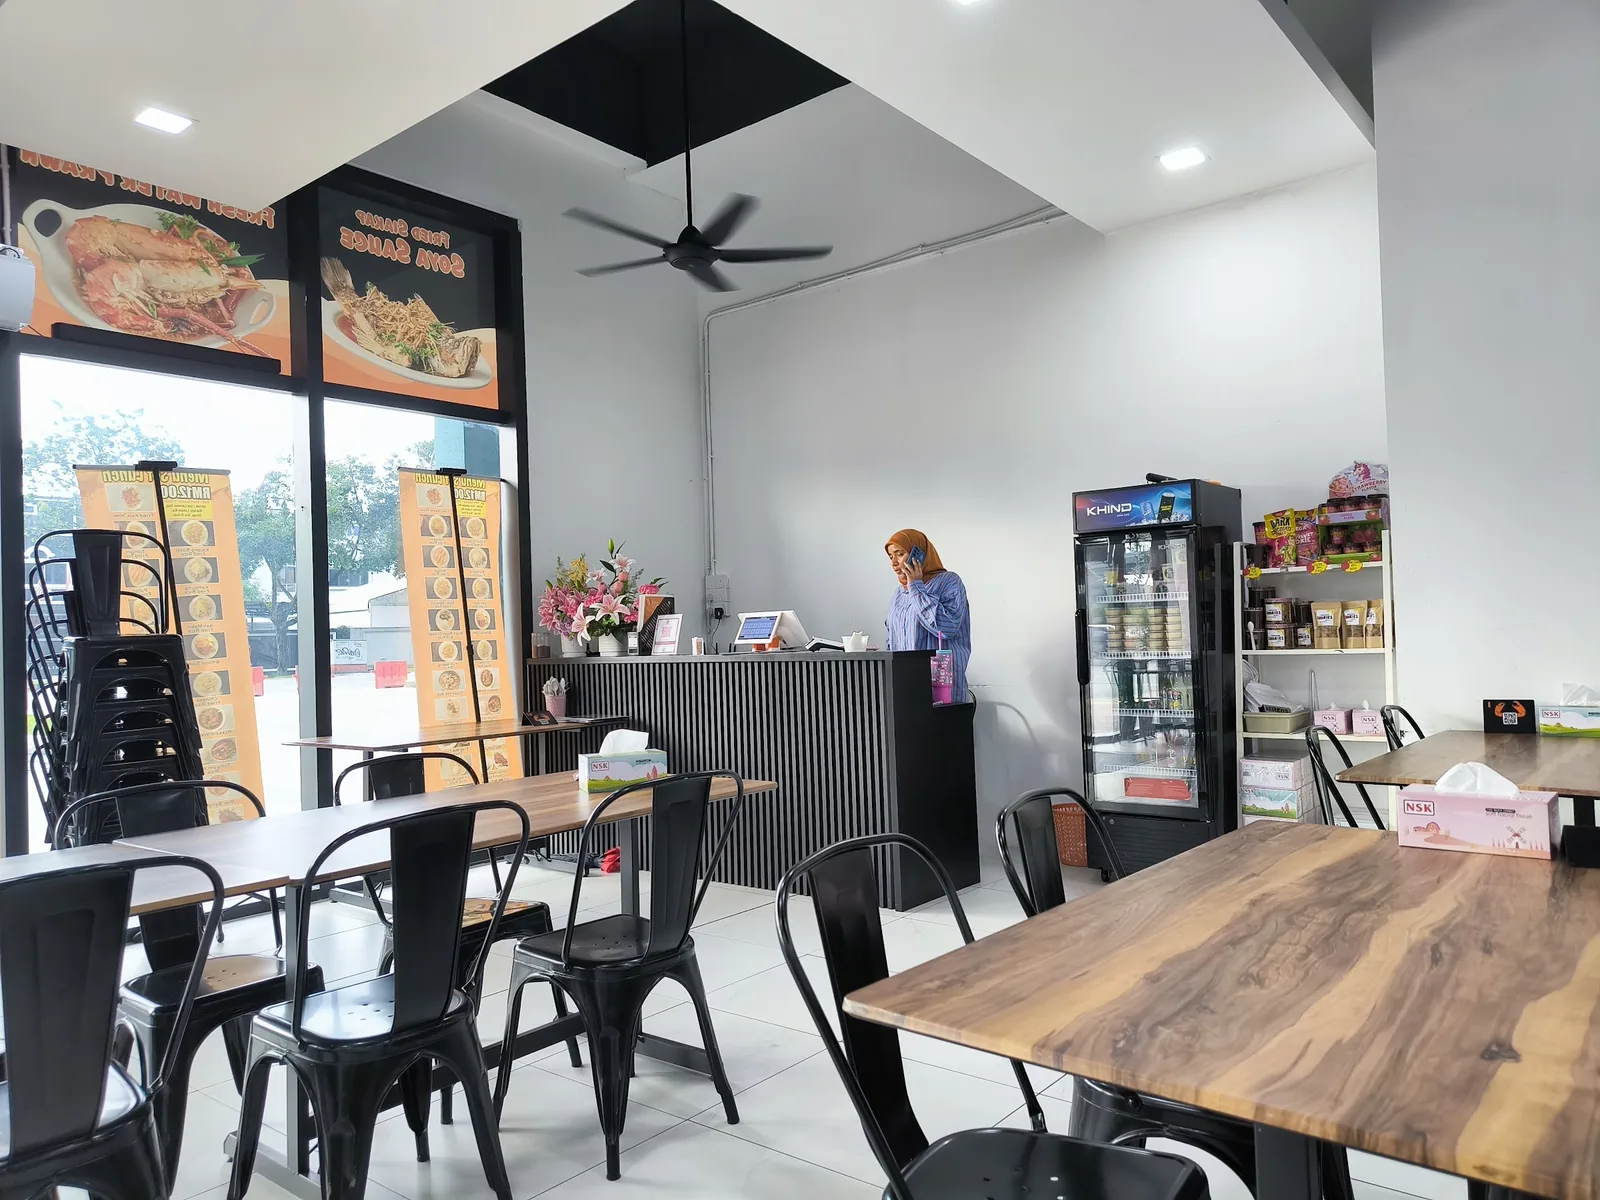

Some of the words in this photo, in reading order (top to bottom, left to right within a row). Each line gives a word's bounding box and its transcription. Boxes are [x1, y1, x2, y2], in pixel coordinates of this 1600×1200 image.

[1087, 503, 1132, 516] KHIND
[1270, 517, 1291, 529] DARK
[592, 761, 609, 770] NSK
[1406, 802, 1433, 814] NSK
